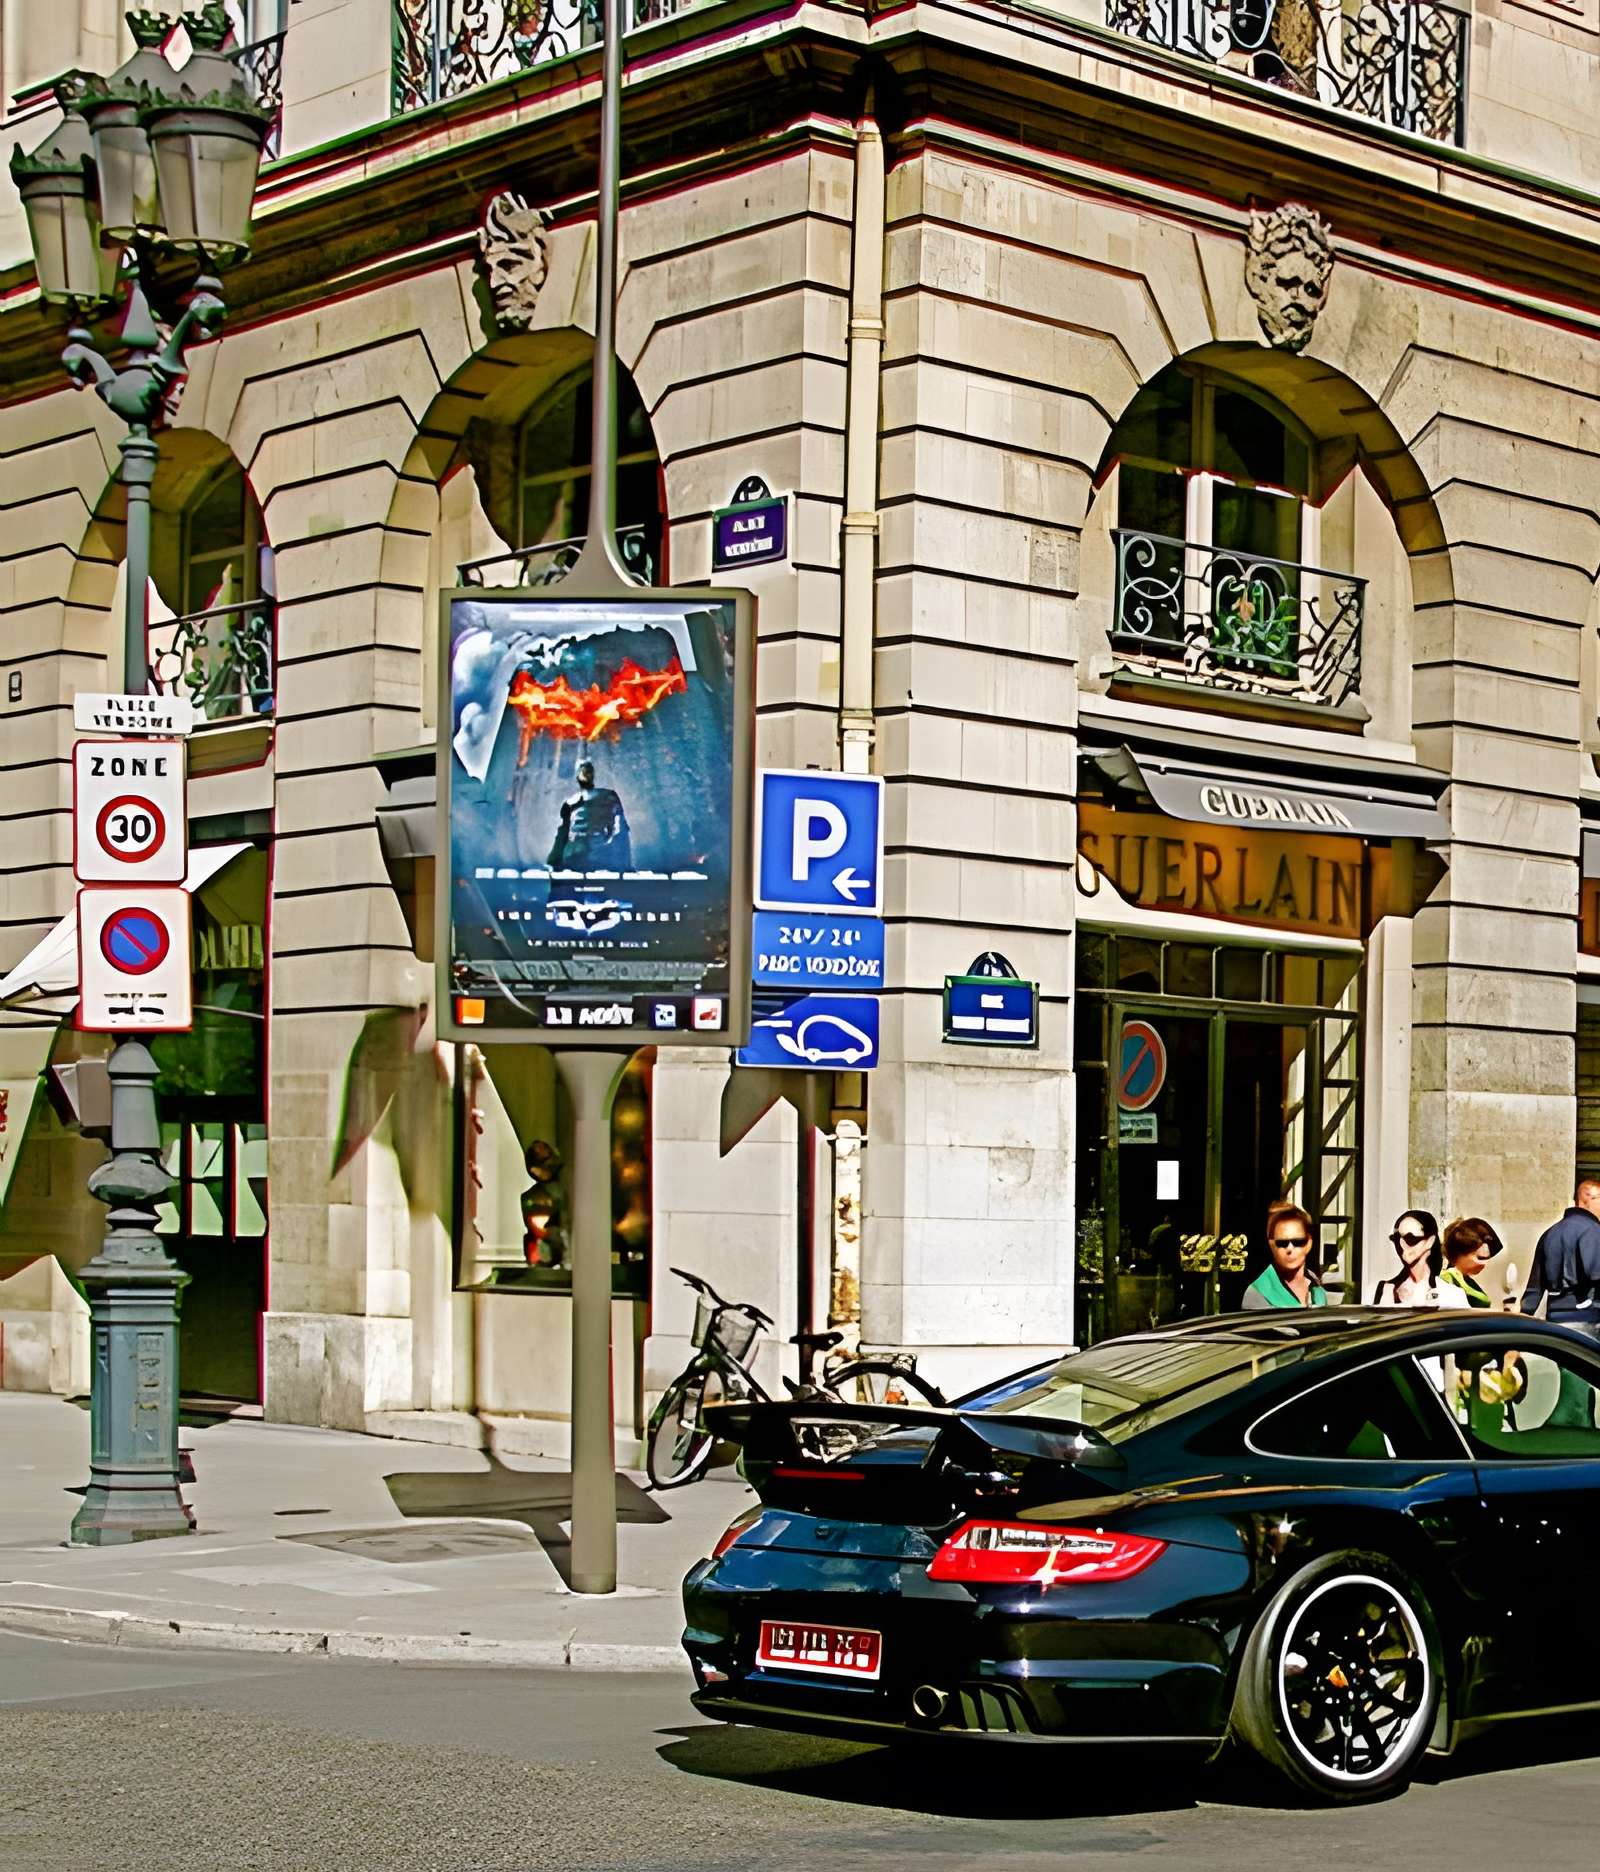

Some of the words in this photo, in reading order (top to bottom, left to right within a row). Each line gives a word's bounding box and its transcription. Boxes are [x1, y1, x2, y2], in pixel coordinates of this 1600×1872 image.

[91, 756, 168, 777] ZONE
[110, 814, 152, 844] 30
[791, 797, 848, 881] P
[1078, 828, 1363, 931] GUERLAIN
